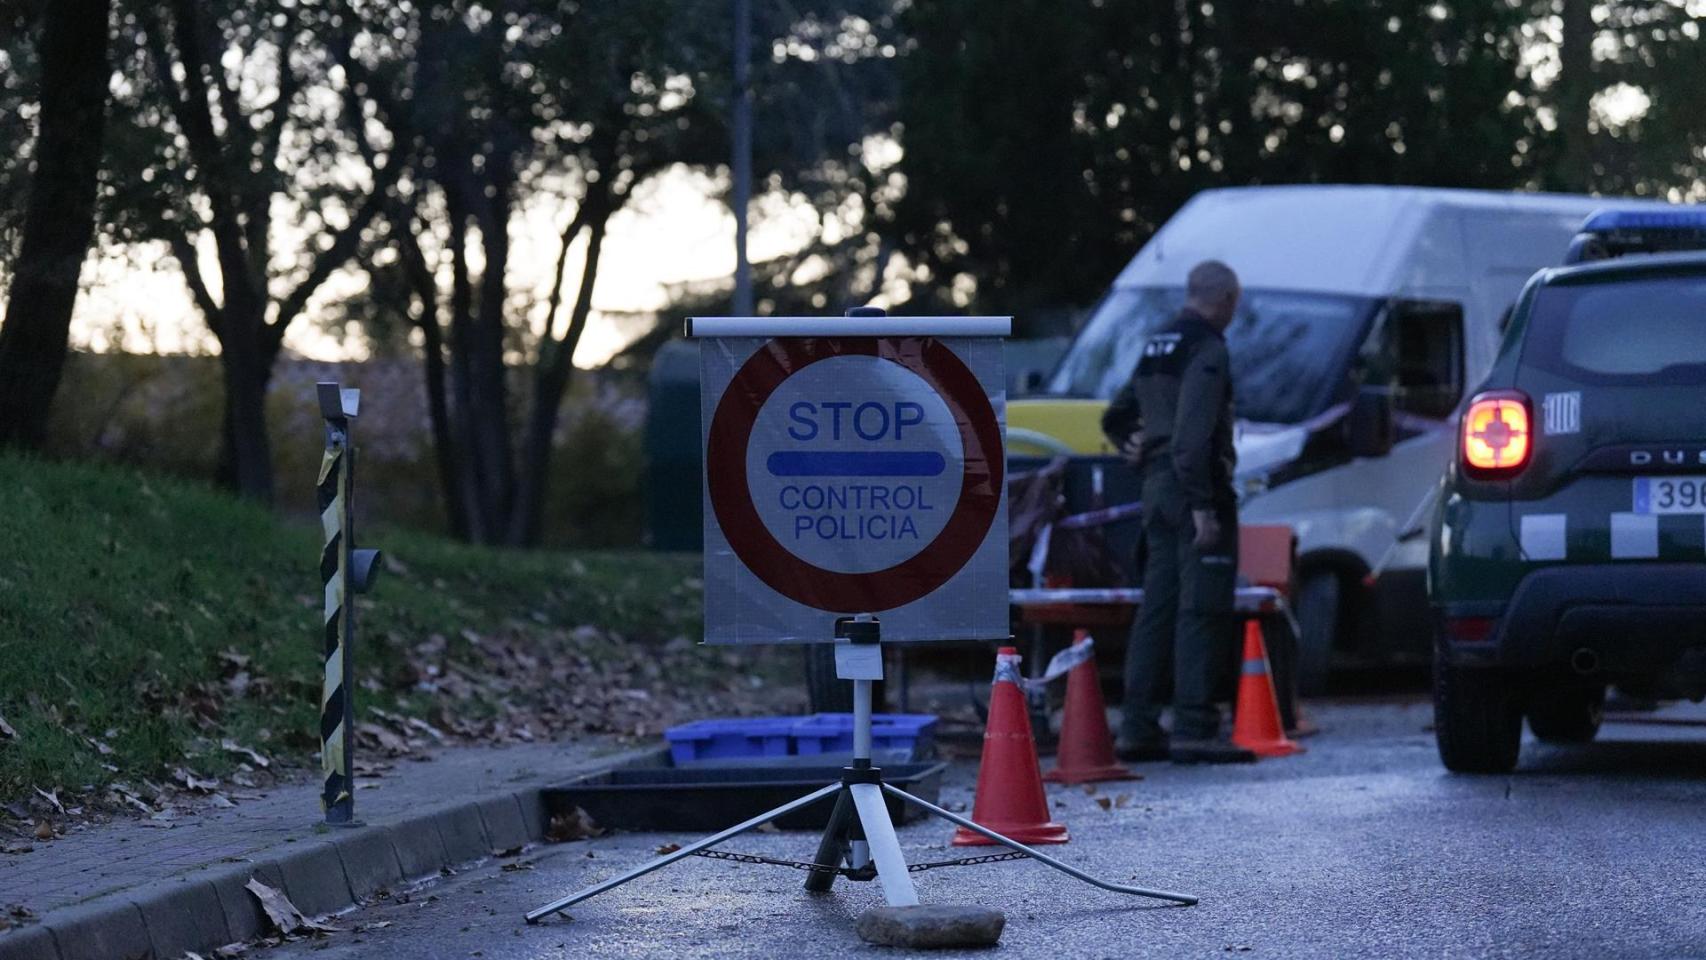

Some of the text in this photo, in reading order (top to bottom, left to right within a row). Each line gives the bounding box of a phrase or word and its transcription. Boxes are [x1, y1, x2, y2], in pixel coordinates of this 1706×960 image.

[788, 402, 924, 441] STOP
[779, 486, 933, 510] CONTROL
[795, 515, 918, 540] POLICIA
